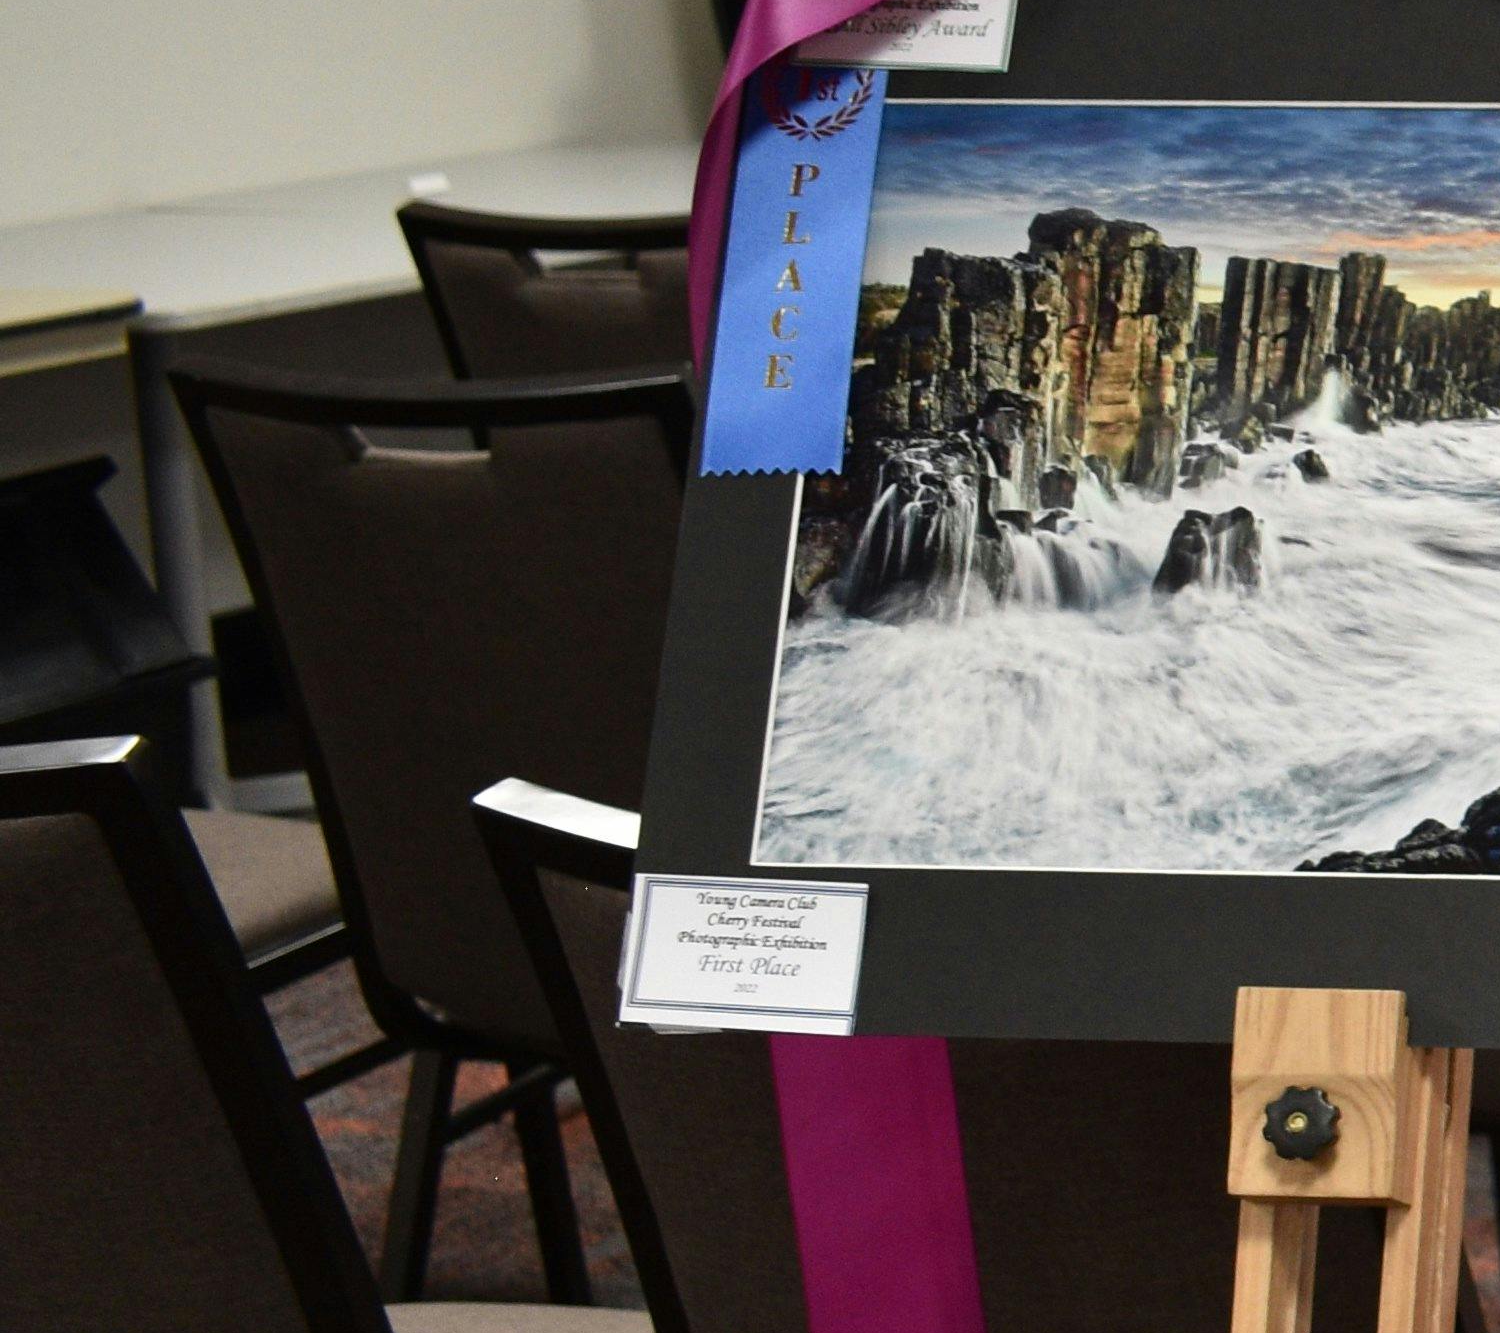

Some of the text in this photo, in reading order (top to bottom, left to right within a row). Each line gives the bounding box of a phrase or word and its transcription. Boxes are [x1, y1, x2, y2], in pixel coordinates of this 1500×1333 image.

[923, 18, 995, 38] Award
[763, 161, 821, 391] PLACE
[696, 892, 818, 911] Young Camera Club
[707, 912, 805, 931] Cherry Festival
[677, 930, 828, 951] Photographic Exhibition
[699, 953, 802, 978] First Place
[733, 982, 758, 994] 2022
